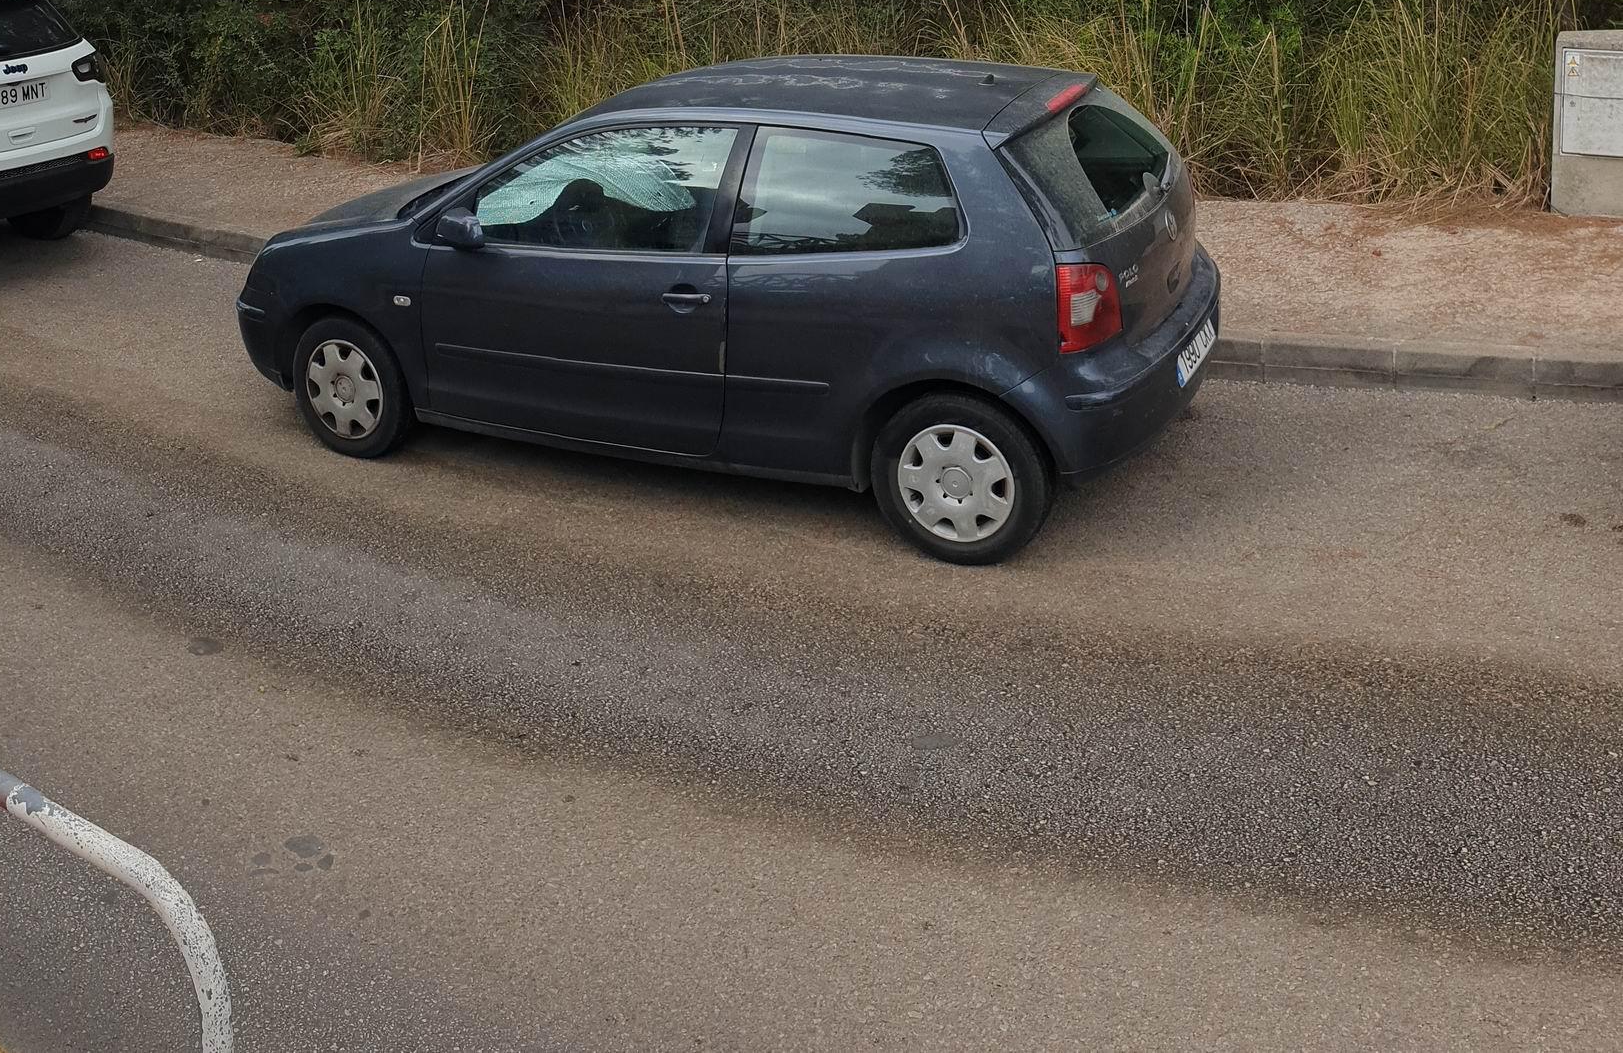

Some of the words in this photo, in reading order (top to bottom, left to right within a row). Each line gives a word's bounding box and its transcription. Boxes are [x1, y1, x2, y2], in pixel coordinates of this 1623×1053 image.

[2, 63, 29, 75] Jeep
[21, 82, 47, 102] MNT
[1180, 338, 1201, 374] 1990
